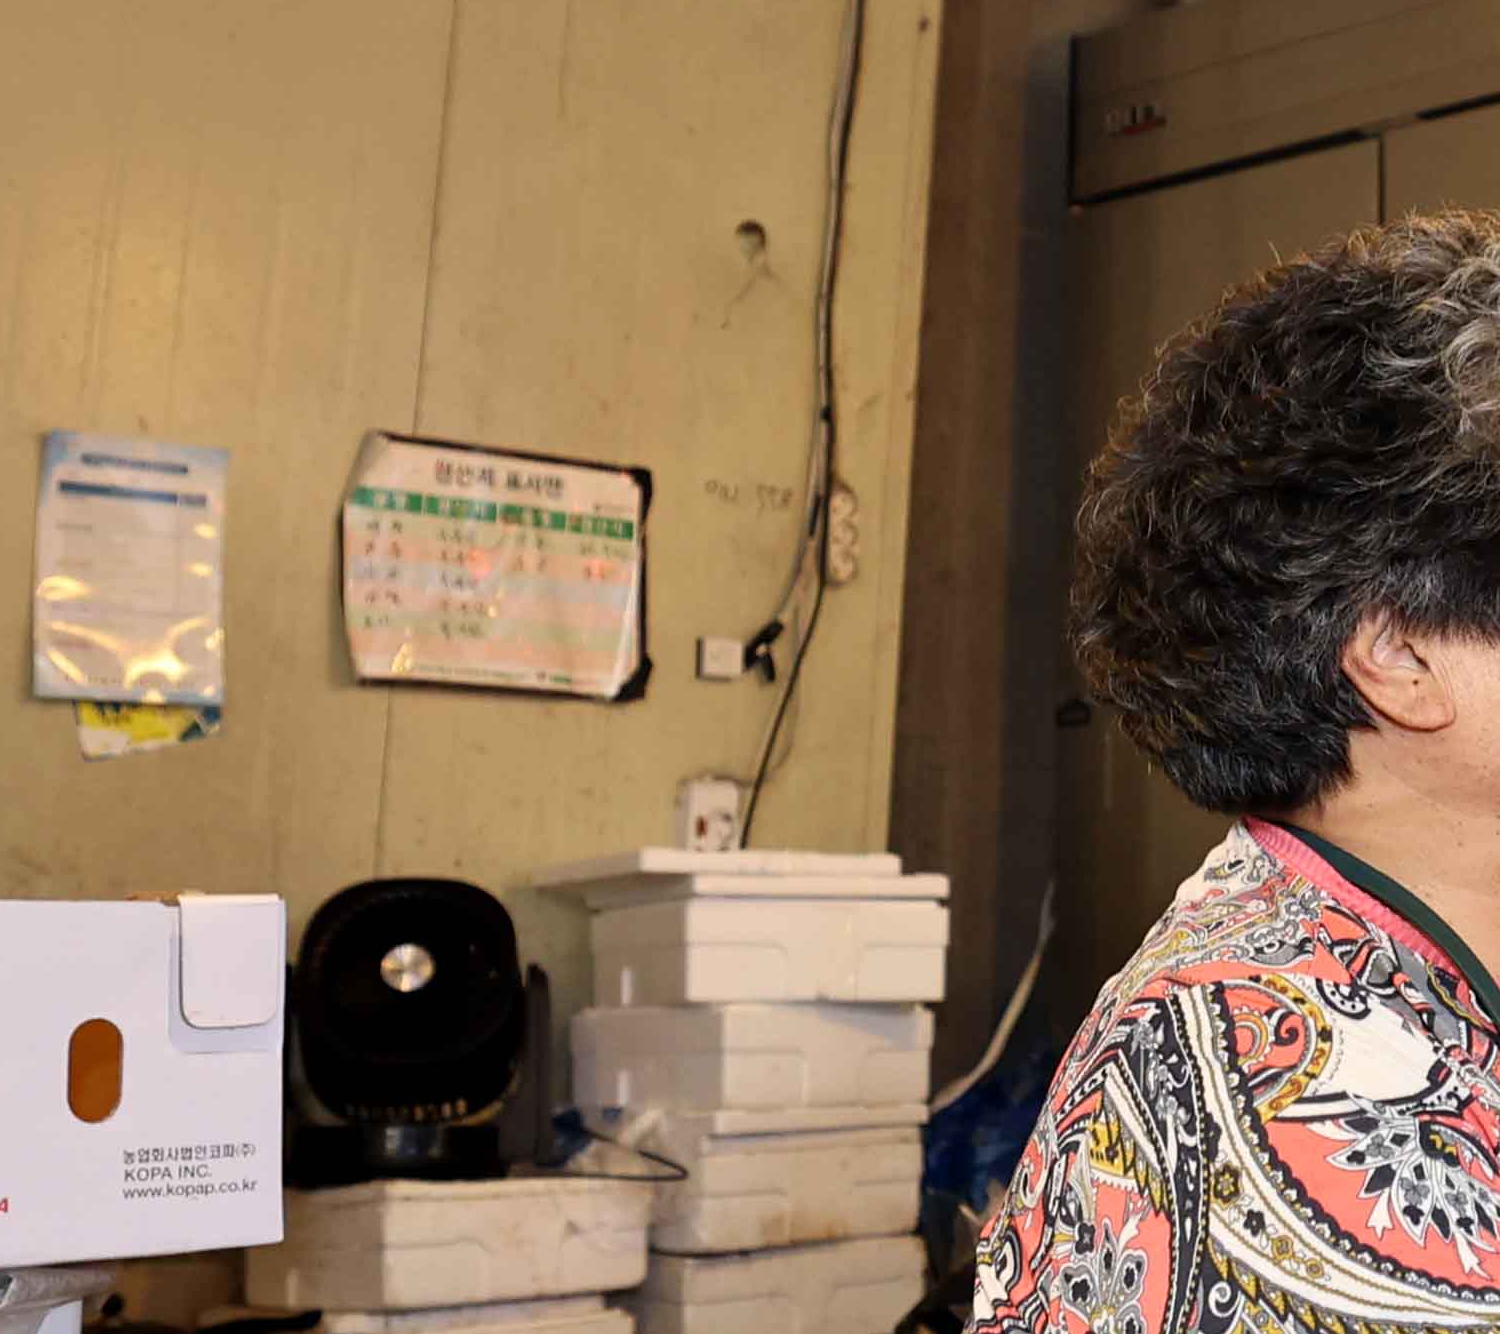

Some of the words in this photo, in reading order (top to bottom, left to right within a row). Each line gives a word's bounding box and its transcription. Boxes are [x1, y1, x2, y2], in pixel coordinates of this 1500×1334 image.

[123, 1166, 173, 1182] KOPA
[177, 1163, 213, 1179] INC.
[121, 1178, 258, 1200] www.kopap.co.kr
